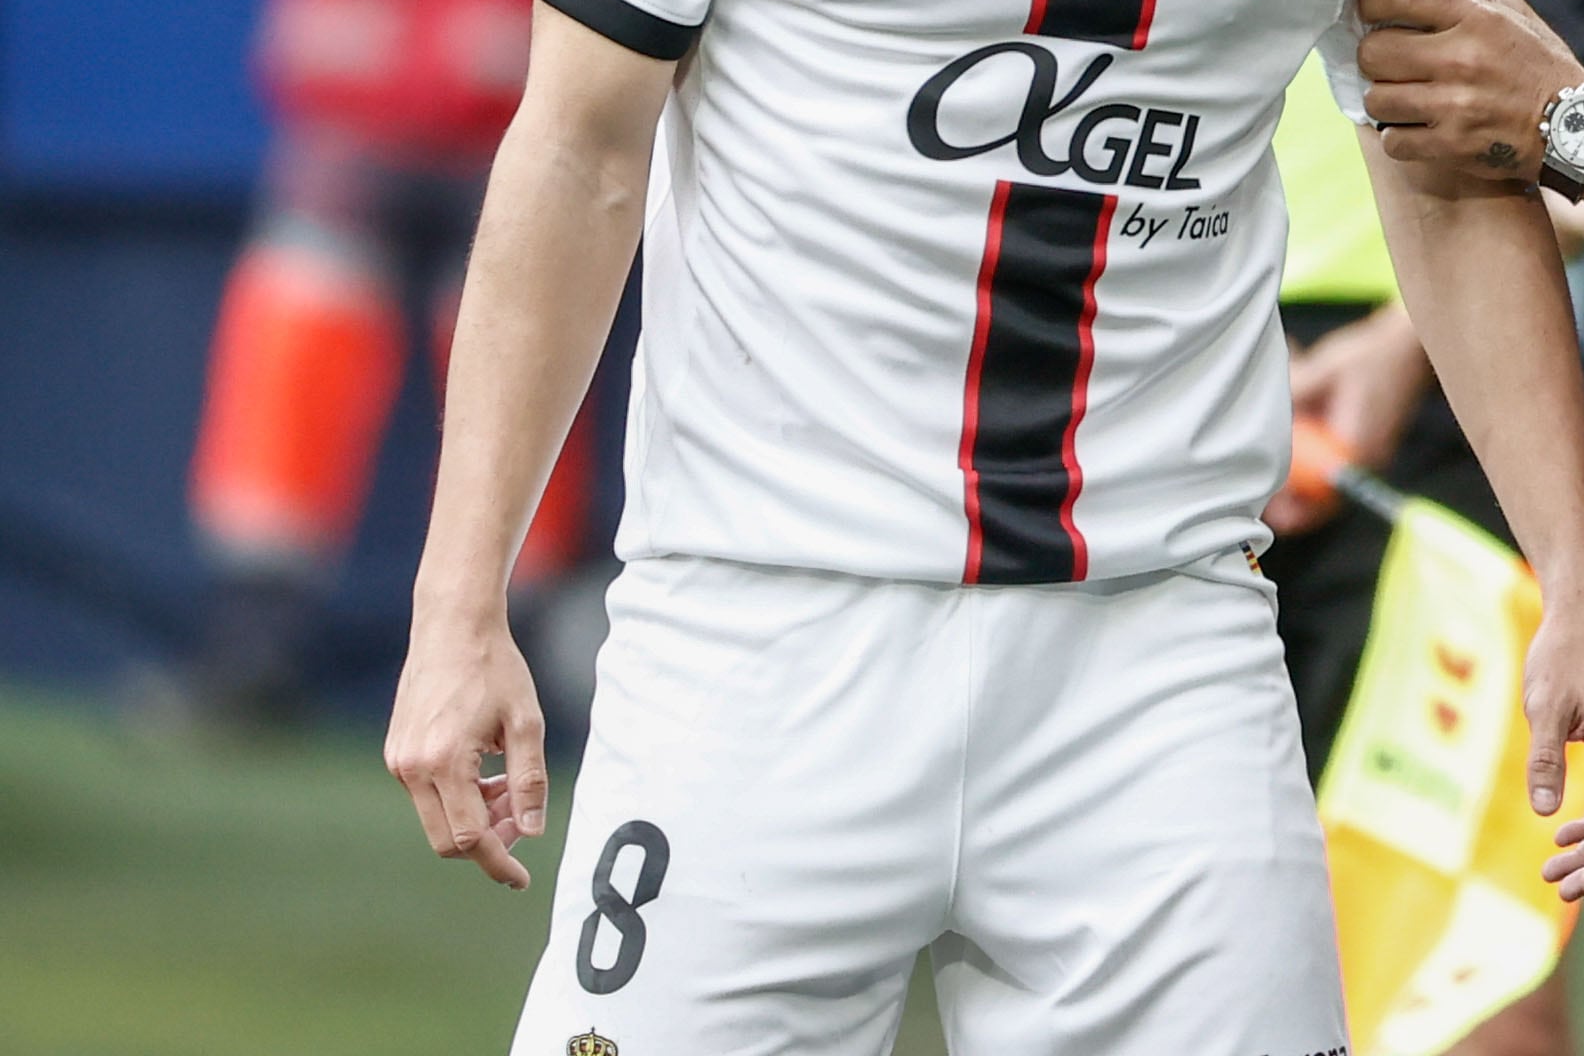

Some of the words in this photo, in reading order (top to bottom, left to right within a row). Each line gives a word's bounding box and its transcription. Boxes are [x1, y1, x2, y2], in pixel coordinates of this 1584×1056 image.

[1119, 202, 1168, 249] by
[1176, 204, 1230, 241] Taica
[575, 819, 671, 996] 8
